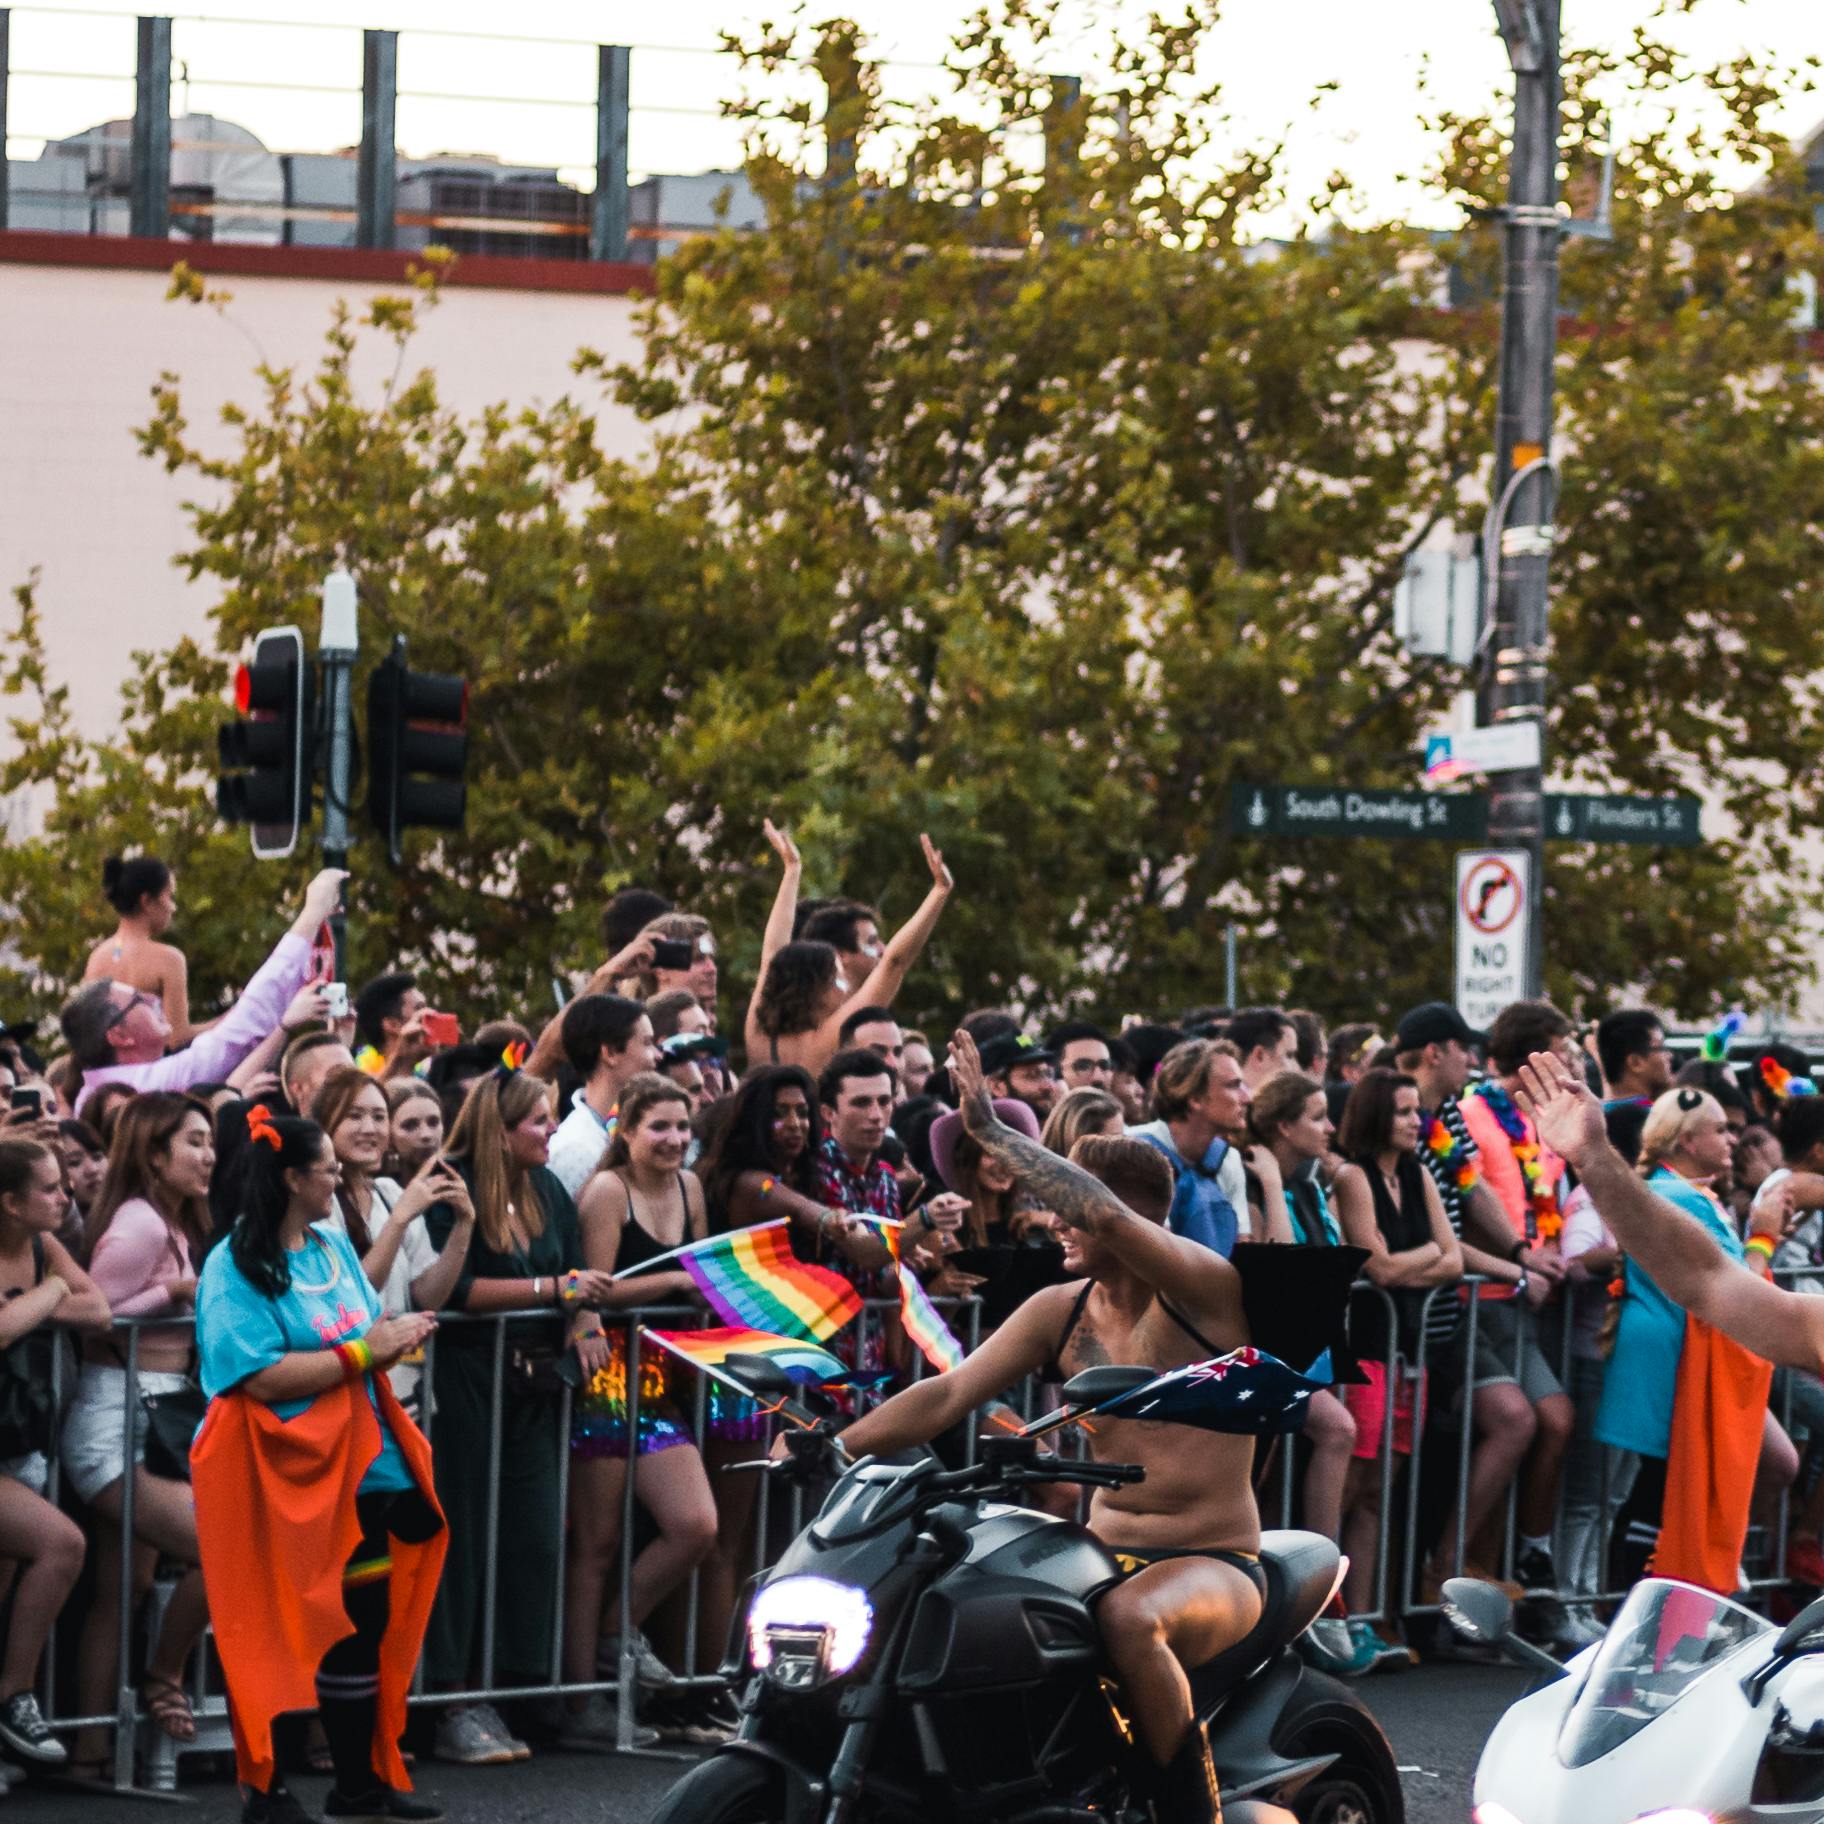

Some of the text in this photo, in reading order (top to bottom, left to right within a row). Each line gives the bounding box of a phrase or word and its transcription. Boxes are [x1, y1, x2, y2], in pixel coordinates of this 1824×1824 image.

[1286, 790, 1341, 820] South
[1345, 793, 1424, 831] Dowling
[1472, 942, 1508, 969] NO
[1465, 977, 1513, 992] RIGHT
